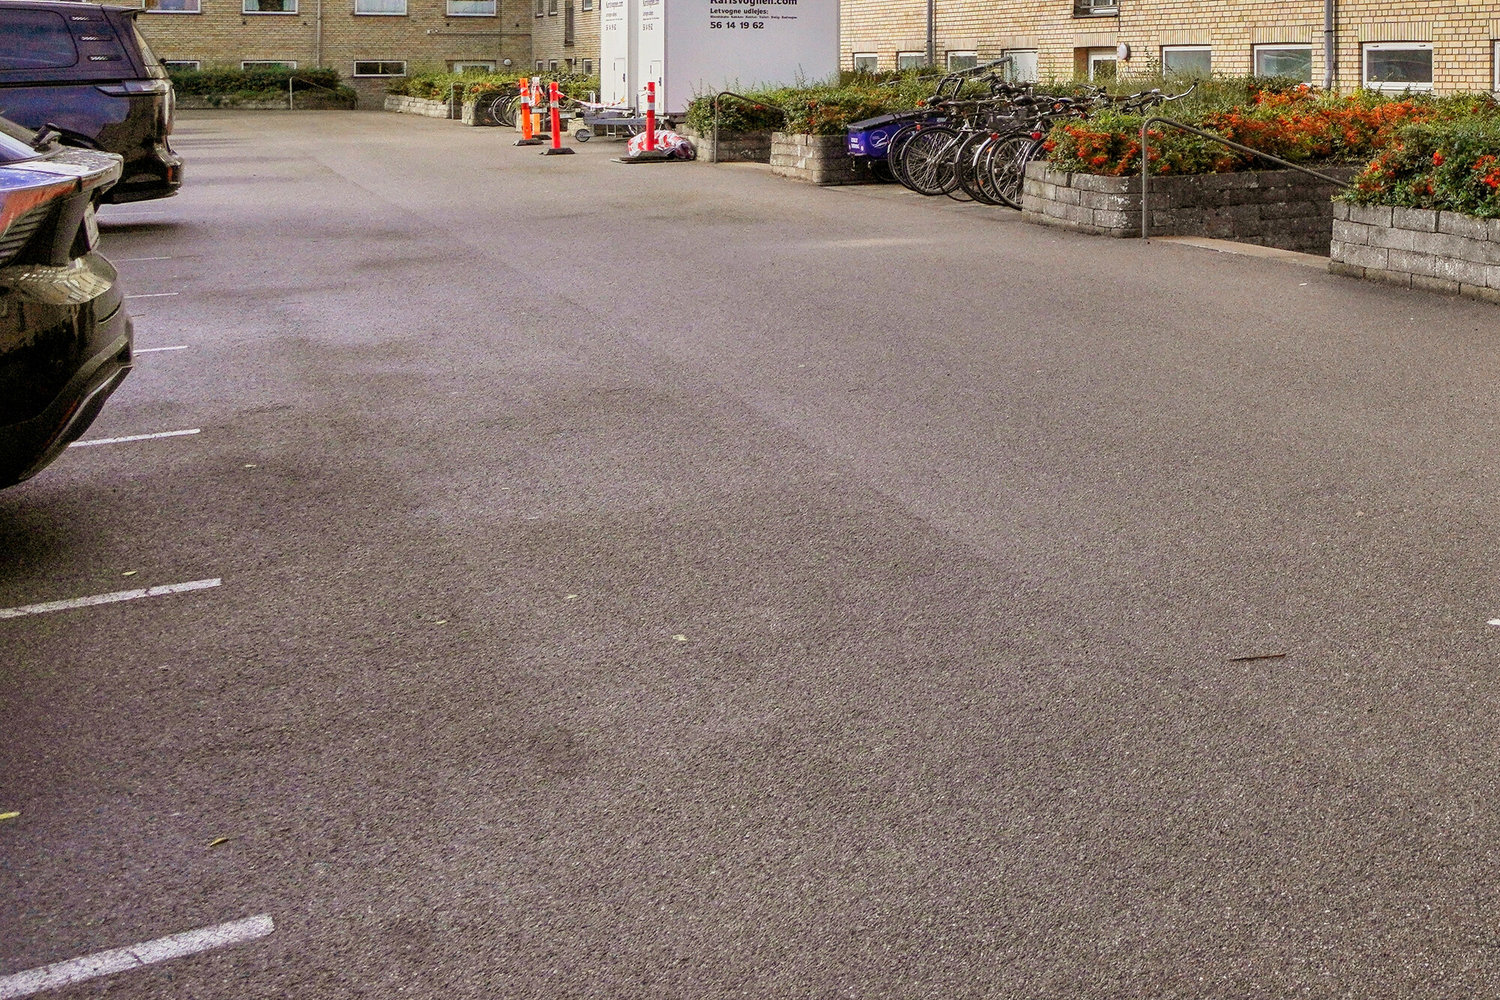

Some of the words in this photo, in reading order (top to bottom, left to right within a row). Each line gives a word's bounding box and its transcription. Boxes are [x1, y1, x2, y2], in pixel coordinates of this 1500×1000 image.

[743, 8, 769, 16] udlejes:
[710, 21, 722, 29] 56
[726, 21, 736, 29] 14
[739, 21, 750, 29] 19
[752, 22, 764, 30] 62
